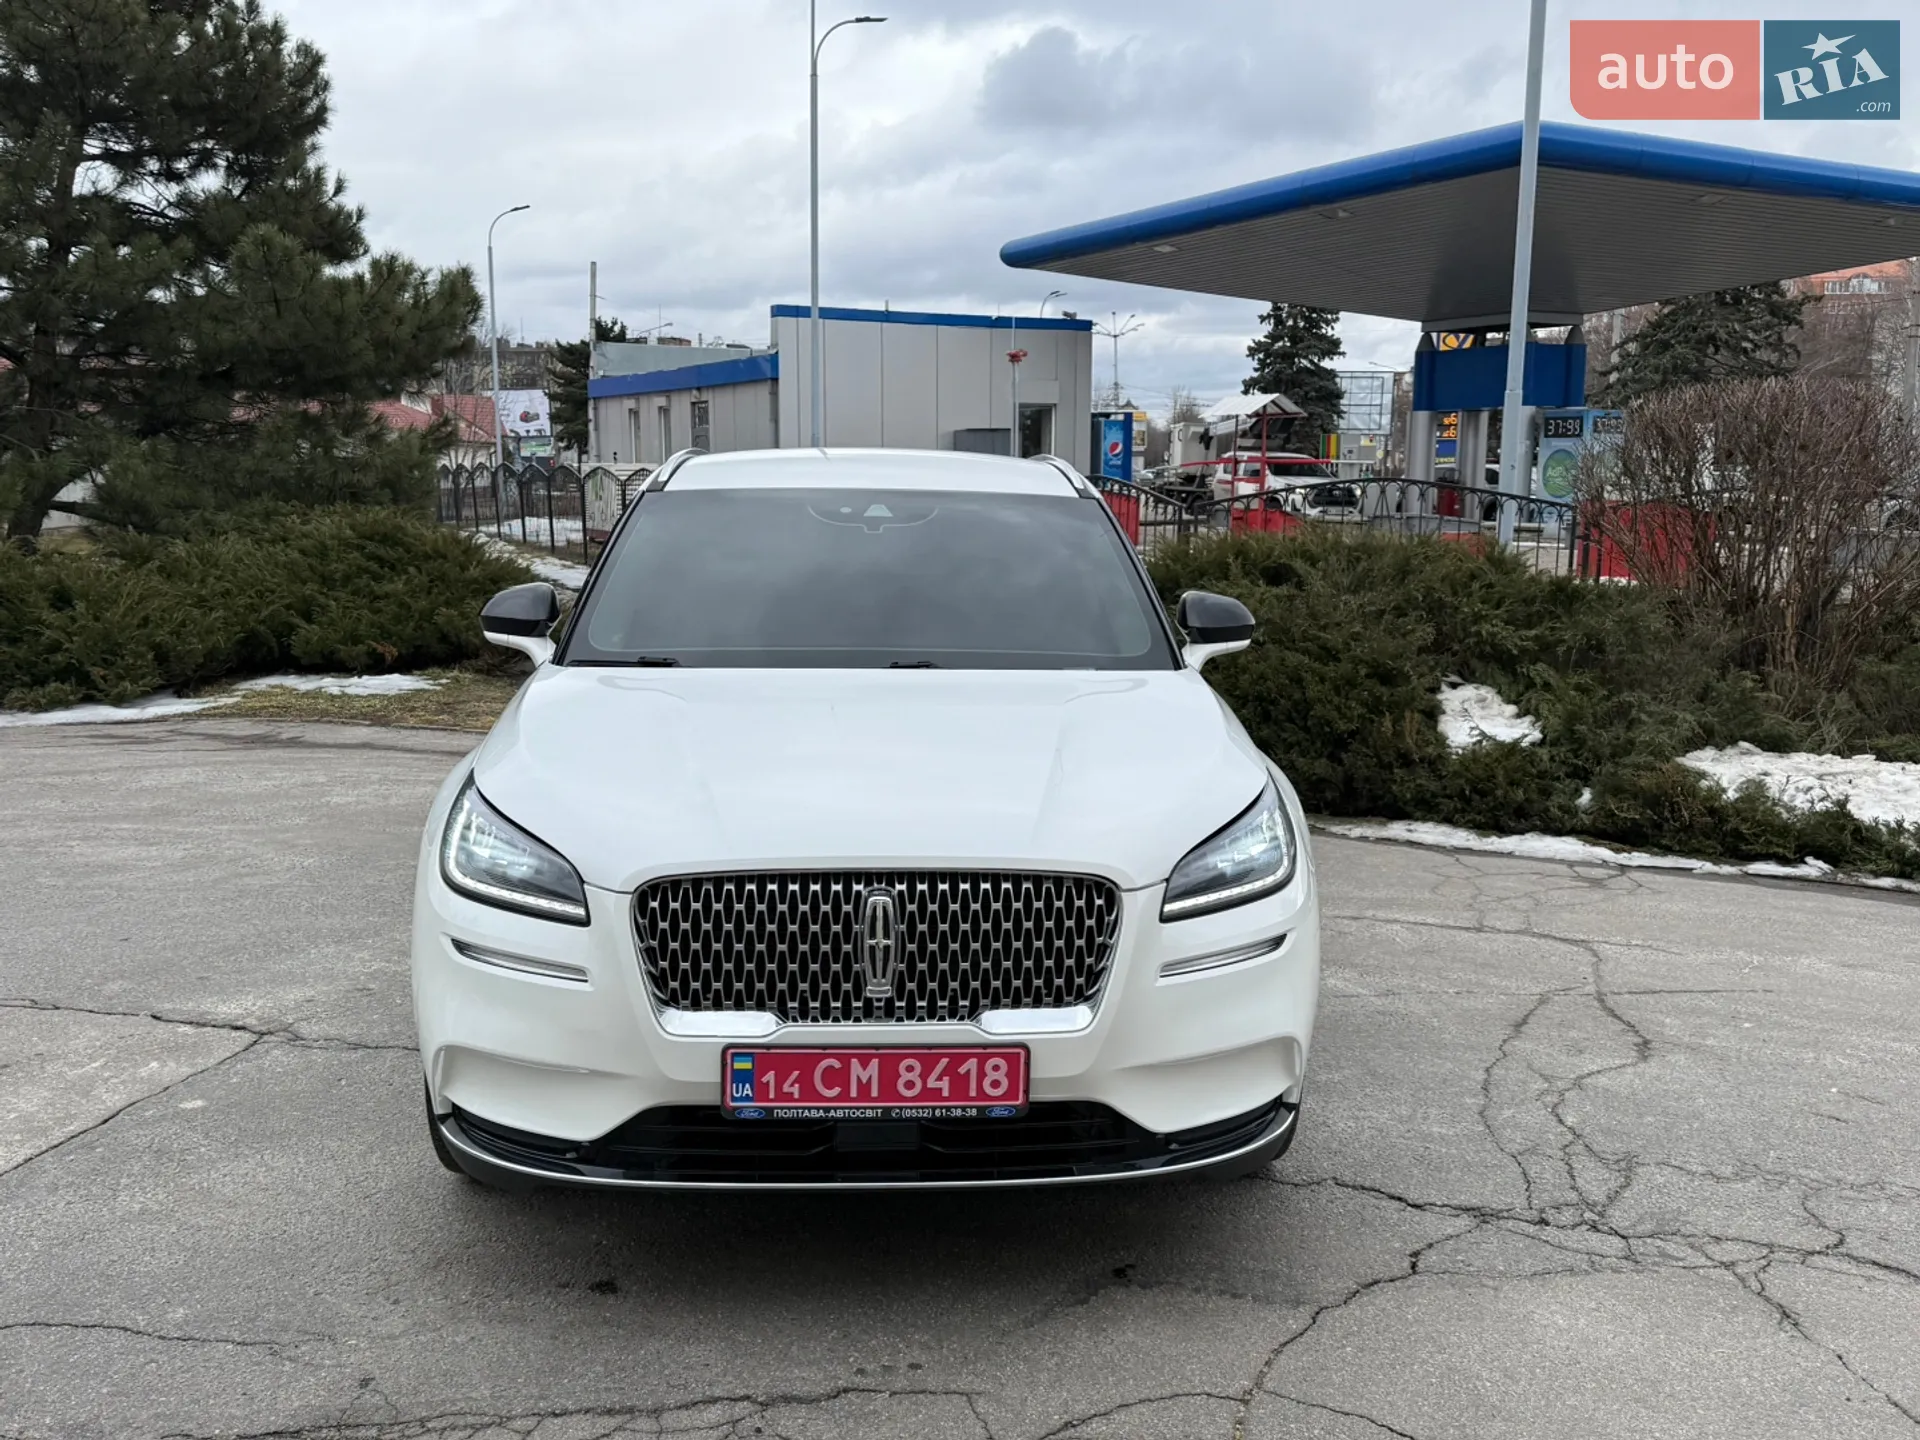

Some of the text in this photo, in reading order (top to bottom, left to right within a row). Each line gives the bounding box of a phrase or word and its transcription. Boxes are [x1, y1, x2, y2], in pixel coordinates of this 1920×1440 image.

[760, 1056, 1009, 1099] 14 CM 8418
[732, 1082, 753, 1098] UA
[773, 1107, 978, 1119] ПОЛТАВА-АВТОСВІТ (0532) 61-38-38
